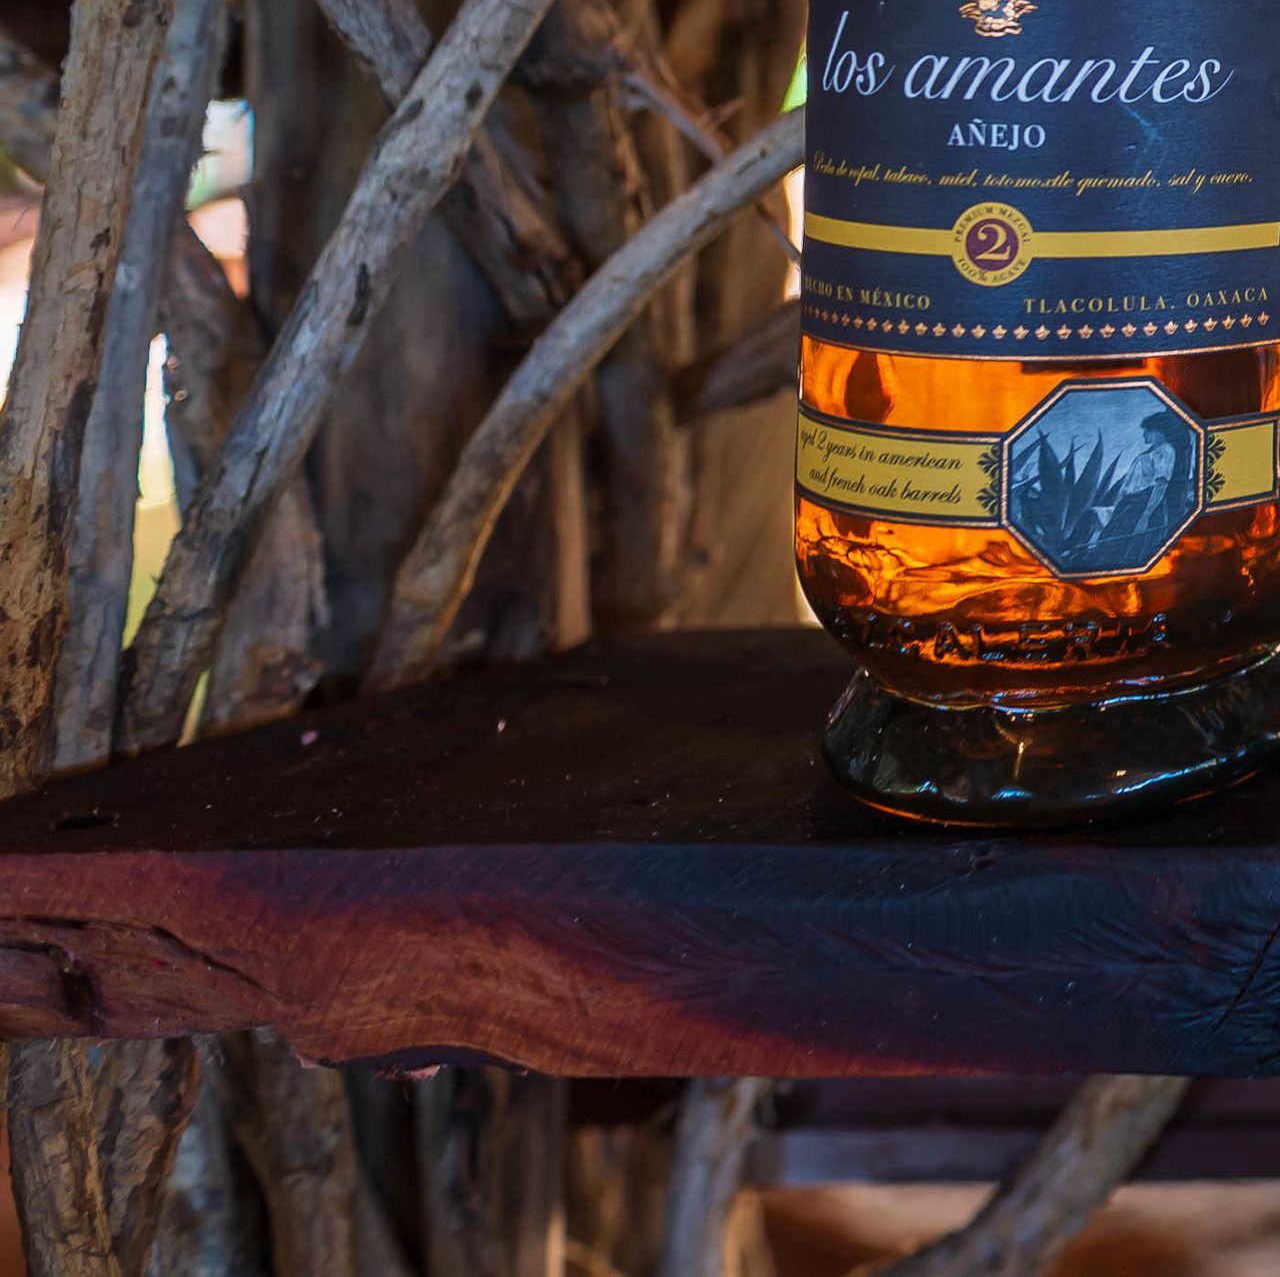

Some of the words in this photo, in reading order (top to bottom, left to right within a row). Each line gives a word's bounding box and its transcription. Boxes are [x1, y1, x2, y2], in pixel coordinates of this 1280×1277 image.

[823, 11, 896, 96] los
[904, 45, 1235, 105] amantes
[947, 118, 1047, 150] AÑEJO
[1168, 168, 1195, 187] sal
[1192, 173, 1206, 194] y
[975, 223, 1012, 261] 2
[837, 285, 854, 301] EN
[860, 287, 931, 310] MÉXICO
[1187, 286, 1269, 308] OAXACA
[818, 431, 828, 451] 2
[859, 446, 875, 461] in
[879, 452, 963, 471] american
[868, 478, 898, 499] oak
[901, 479, 962, 505] barrels
